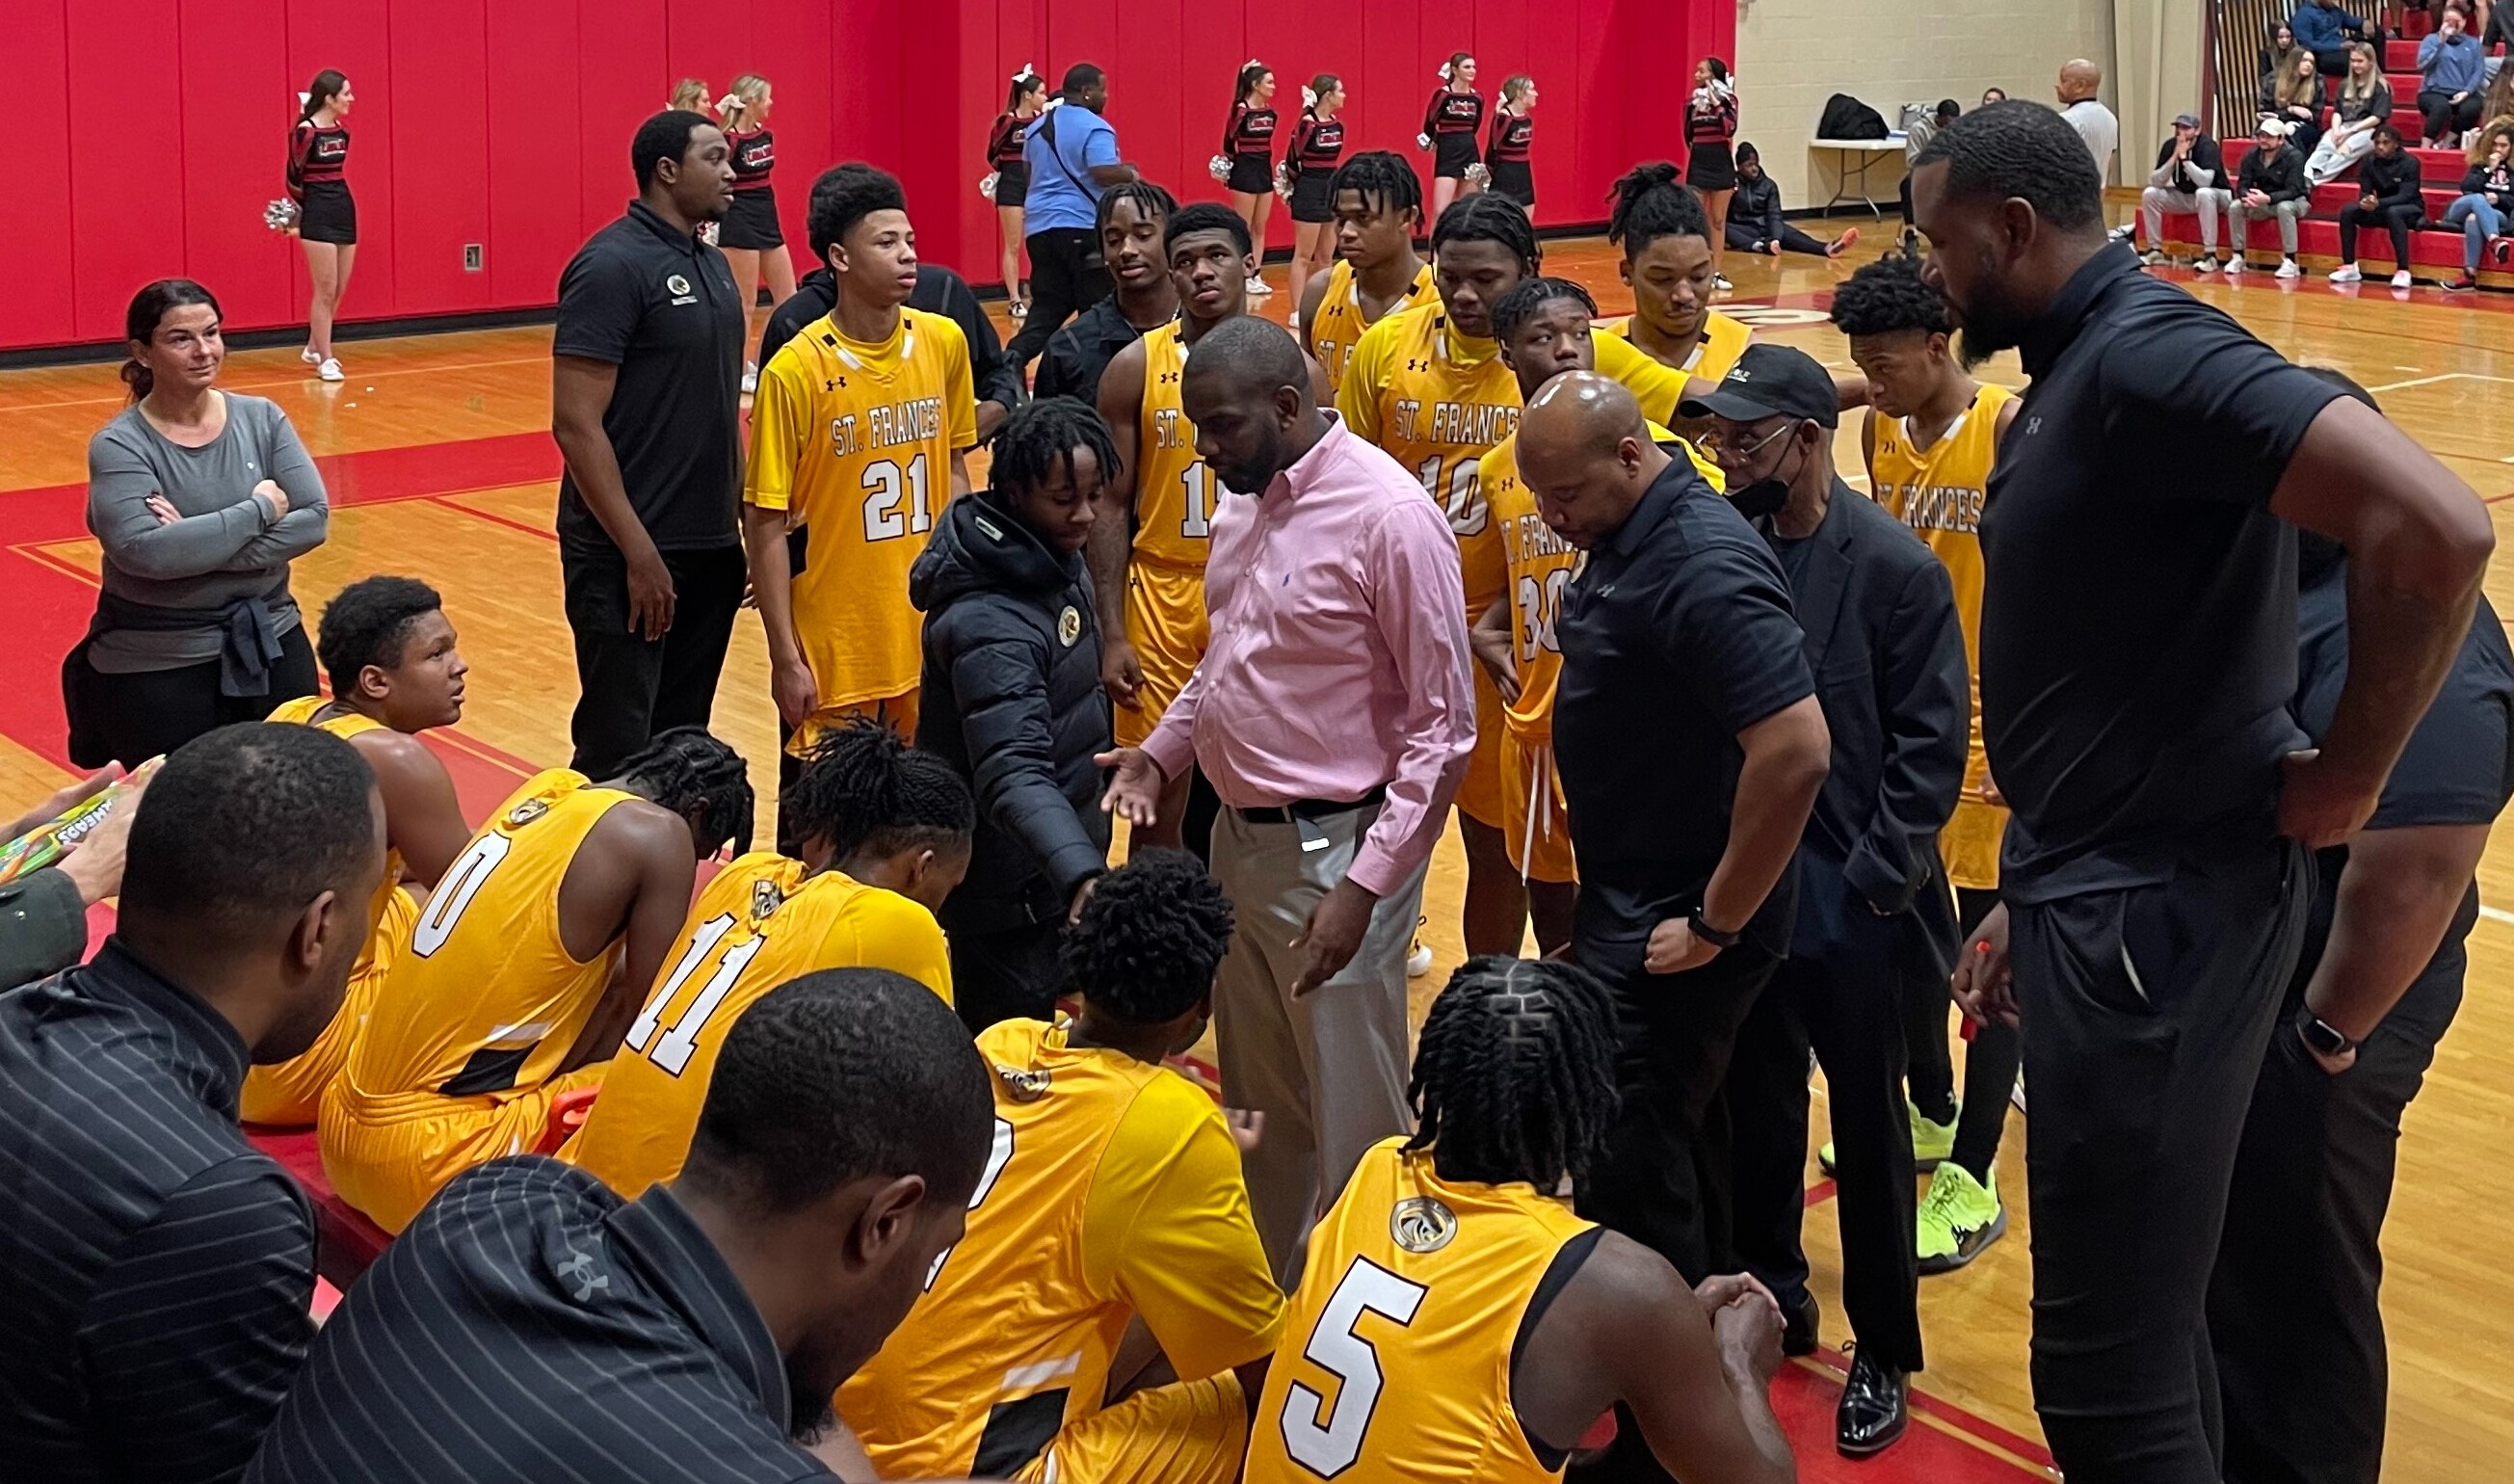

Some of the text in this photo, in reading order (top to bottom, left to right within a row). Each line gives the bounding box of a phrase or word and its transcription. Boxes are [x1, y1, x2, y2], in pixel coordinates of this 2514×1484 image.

[831, 396, 940, 457] ST. FRANCE
[1154, 409, 1185, 449] ST.
[1395, 399, 1522, 446] ST. FRANCE
[860, 453, 932, 543] 21
[1417, 454, 1490, 537] 10
[1518, 568, 1572, 663] 30
[411, 829, 512, 959] 0
[624, 912, 767, 1078] 11
[1279, 1253, 1430, 1482] 5
